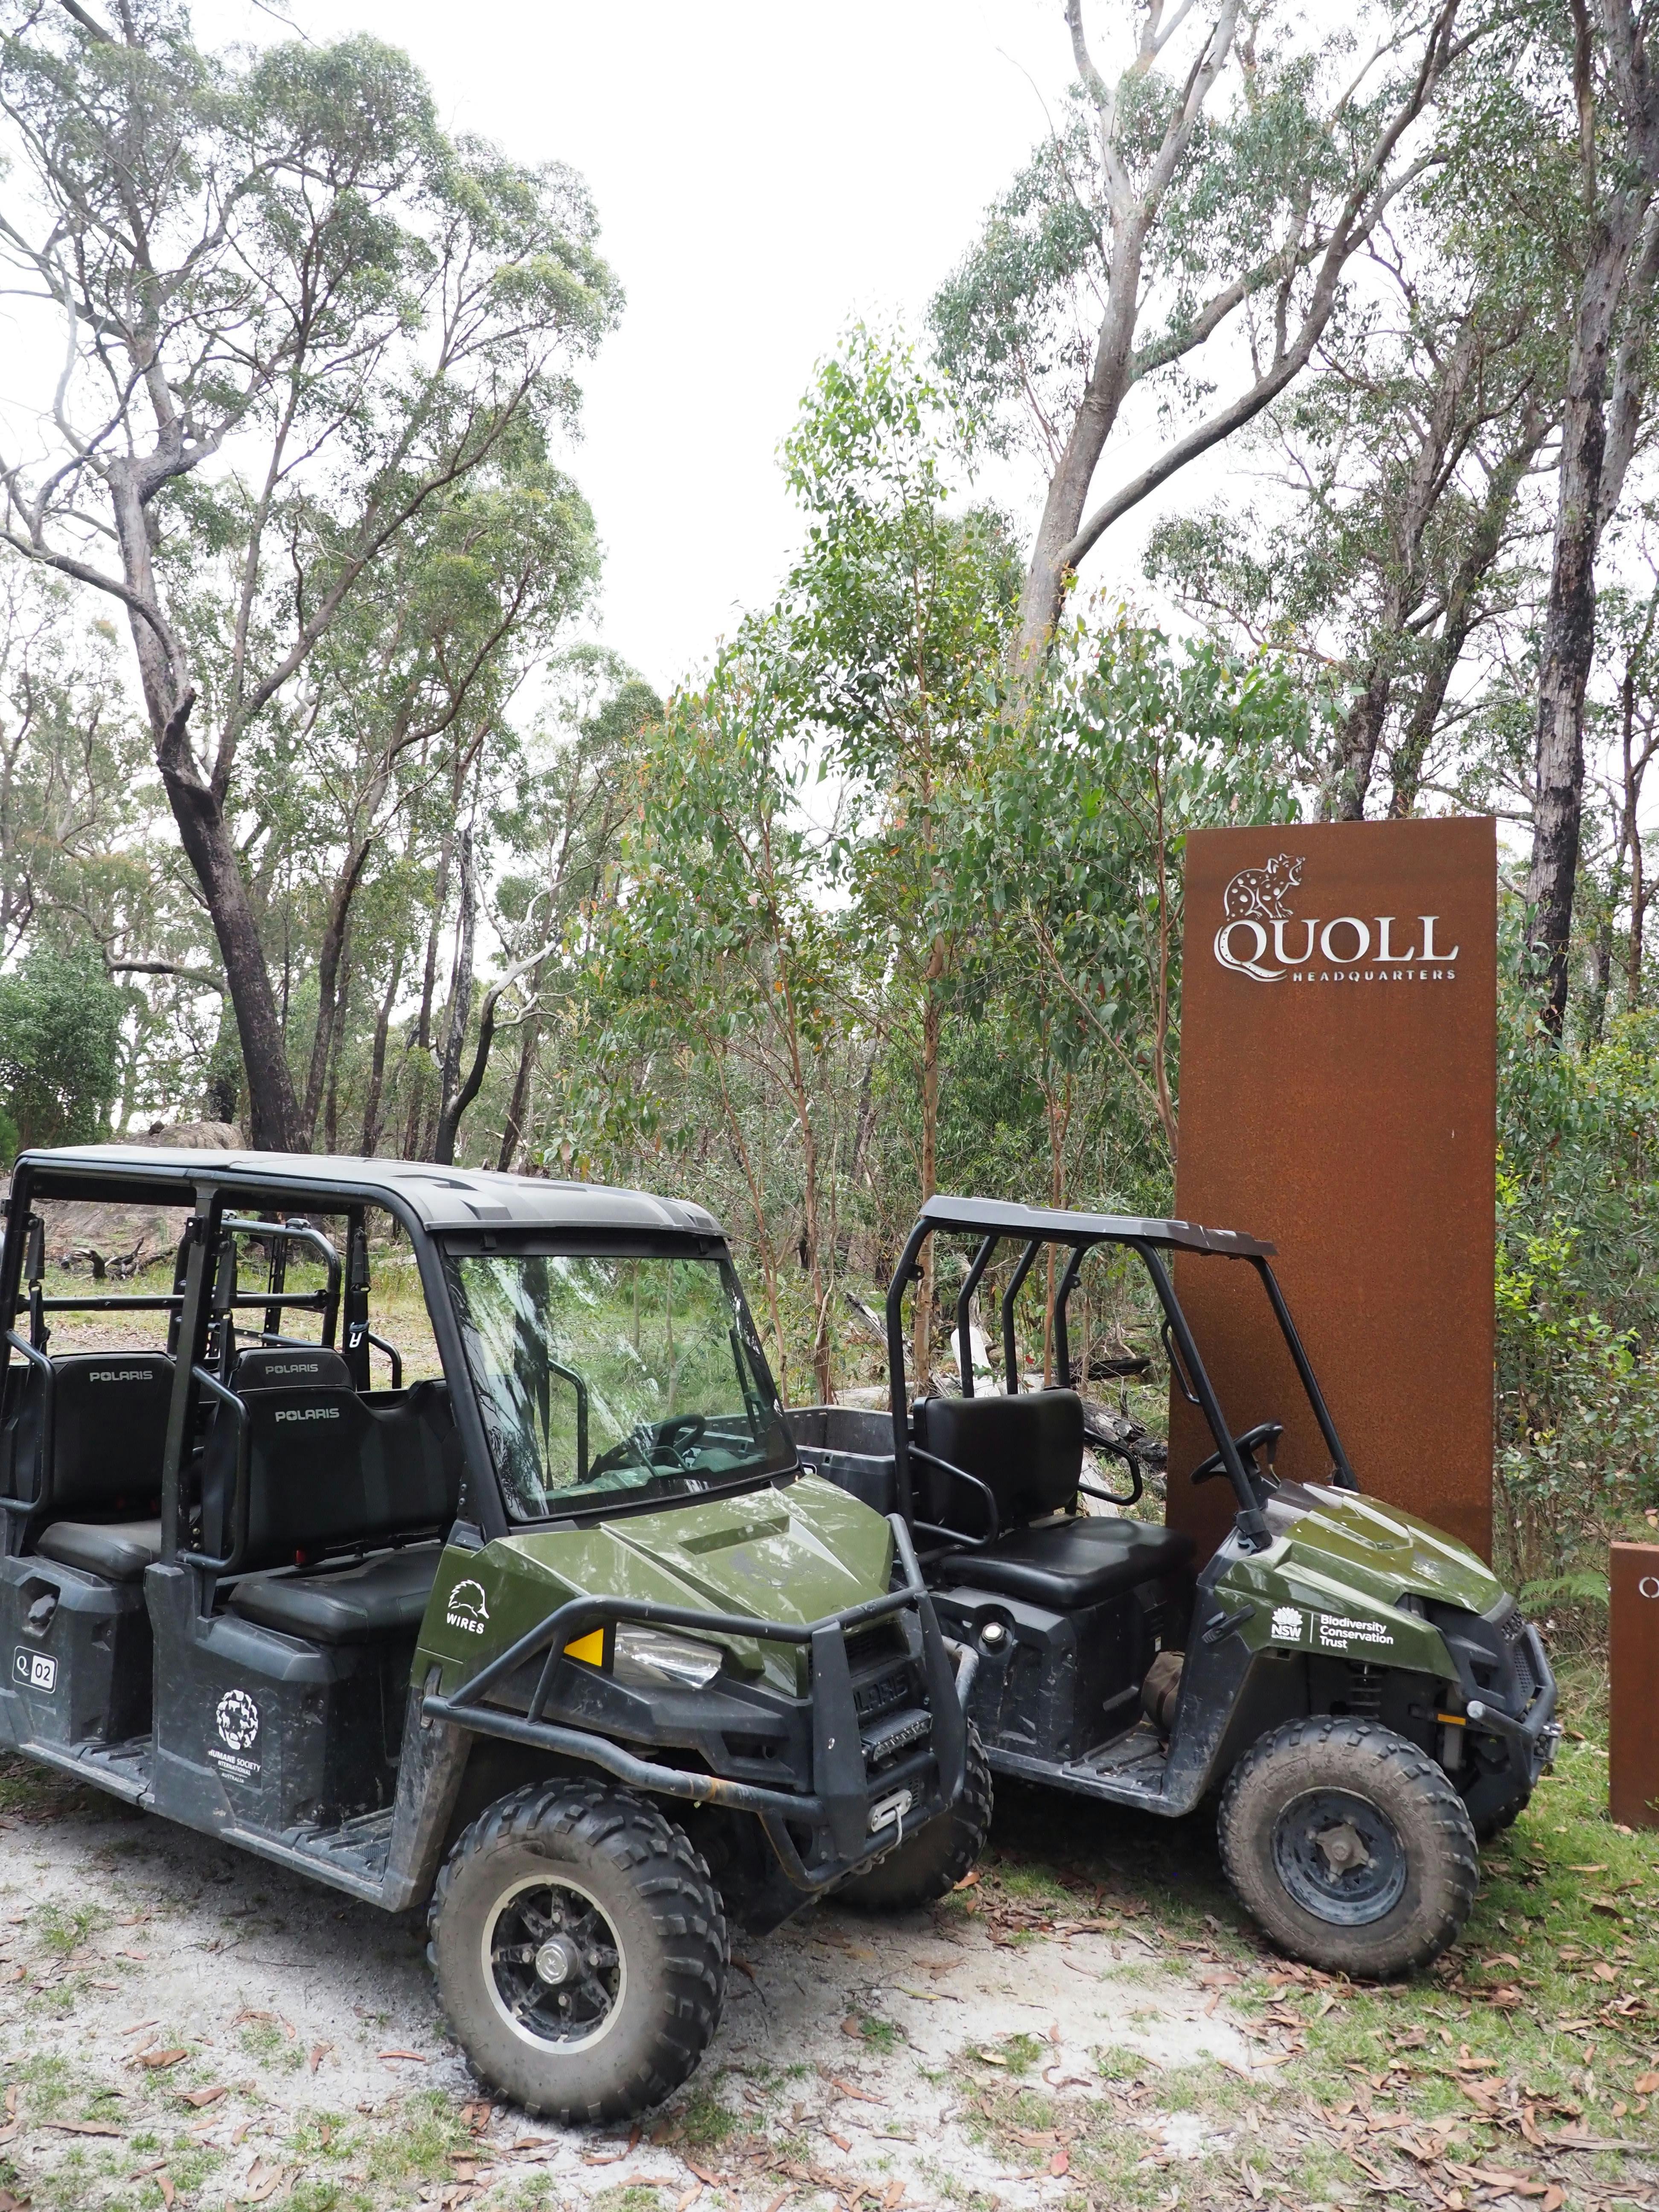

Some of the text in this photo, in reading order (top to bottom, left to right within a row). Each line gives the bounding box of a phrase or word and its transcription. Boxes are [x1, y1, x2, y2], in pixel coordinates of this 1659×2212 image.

[1214, 916, 1459, 981] QUOLL
[1293, 969, 1455, 982] HEADQUARTERS
[90, 1371, 153, 1382] POLARIS
[265, 1364, 318, 1374] POLARIS
[275, 1408, 340, 1422] POLARIS
[447, 1612, 484, 1634] WIRES
[1272, 1624, 1301, 1638] NSW
[1321, 1614, 1387, 1634] Biodiversity
[1319, 1625, 1394, 1644] Conservation
[1319, 1636, 1348, 1649] Trust
[17, 1656, 50, 1681] Q 02
[853, 1674, 908, 1715] LARIS
[207, 1749, 261, 1773] HUMANE SOCIETY
